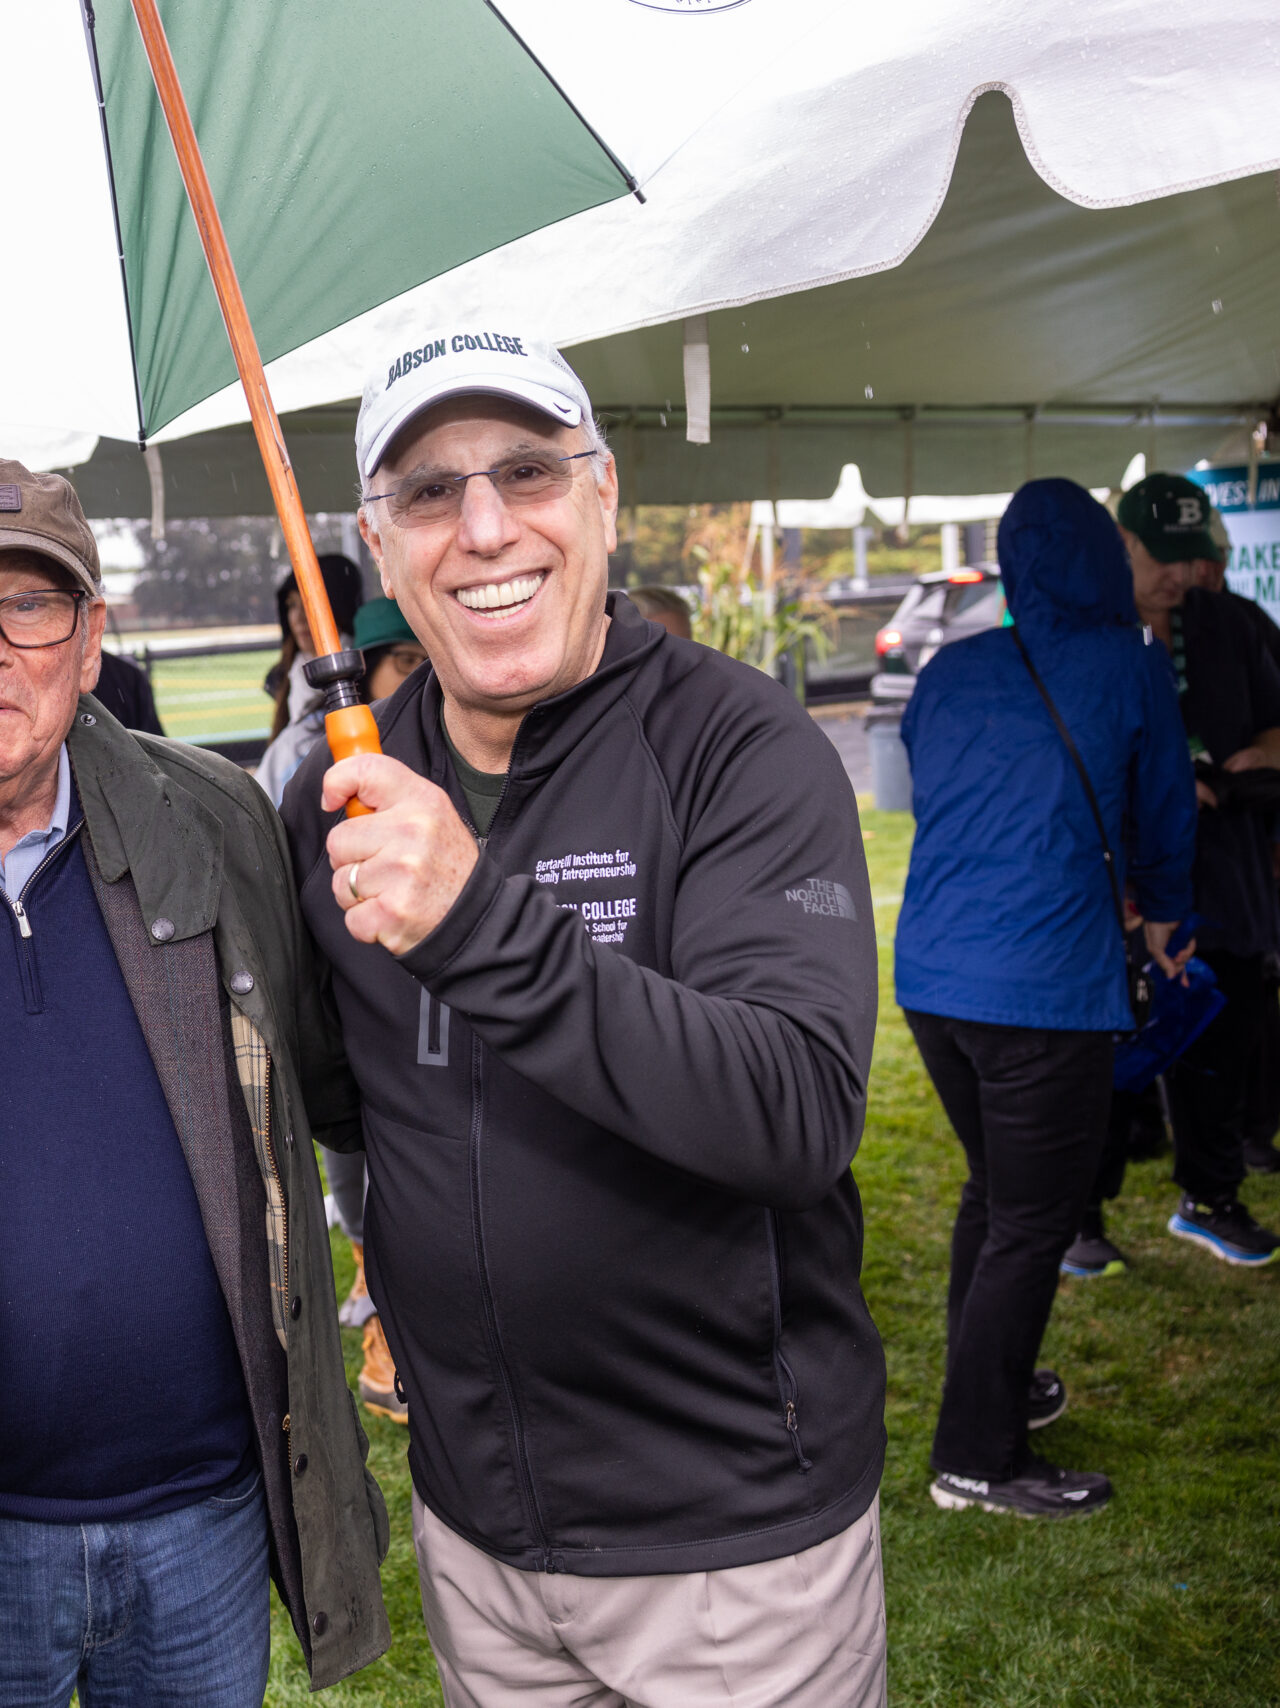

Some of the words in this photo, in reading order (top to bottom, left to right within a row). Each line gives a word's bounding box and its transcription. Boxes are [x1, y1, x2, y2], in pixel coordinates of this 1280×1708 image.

[385, 339, 447, 391] BABSON
[451, 332, 528, 357] COLLEGE
[1176, 497, 1202, 525] B
[573, 851, 614, 866] Institute
[615, 849, 630, 863] for
[561, 861, 637, 881] Entrepreneurship
[806, 878, 835, 893] THE
[784, 888, 838, 905] NORTH
[582, 898, 637, 920] COLLEGE
[803, 901, 840, 917] FACE
[592, 921, 616, 933] School
[617, 919, 628, 931] for
[591, 931, 624, 943] eadership
